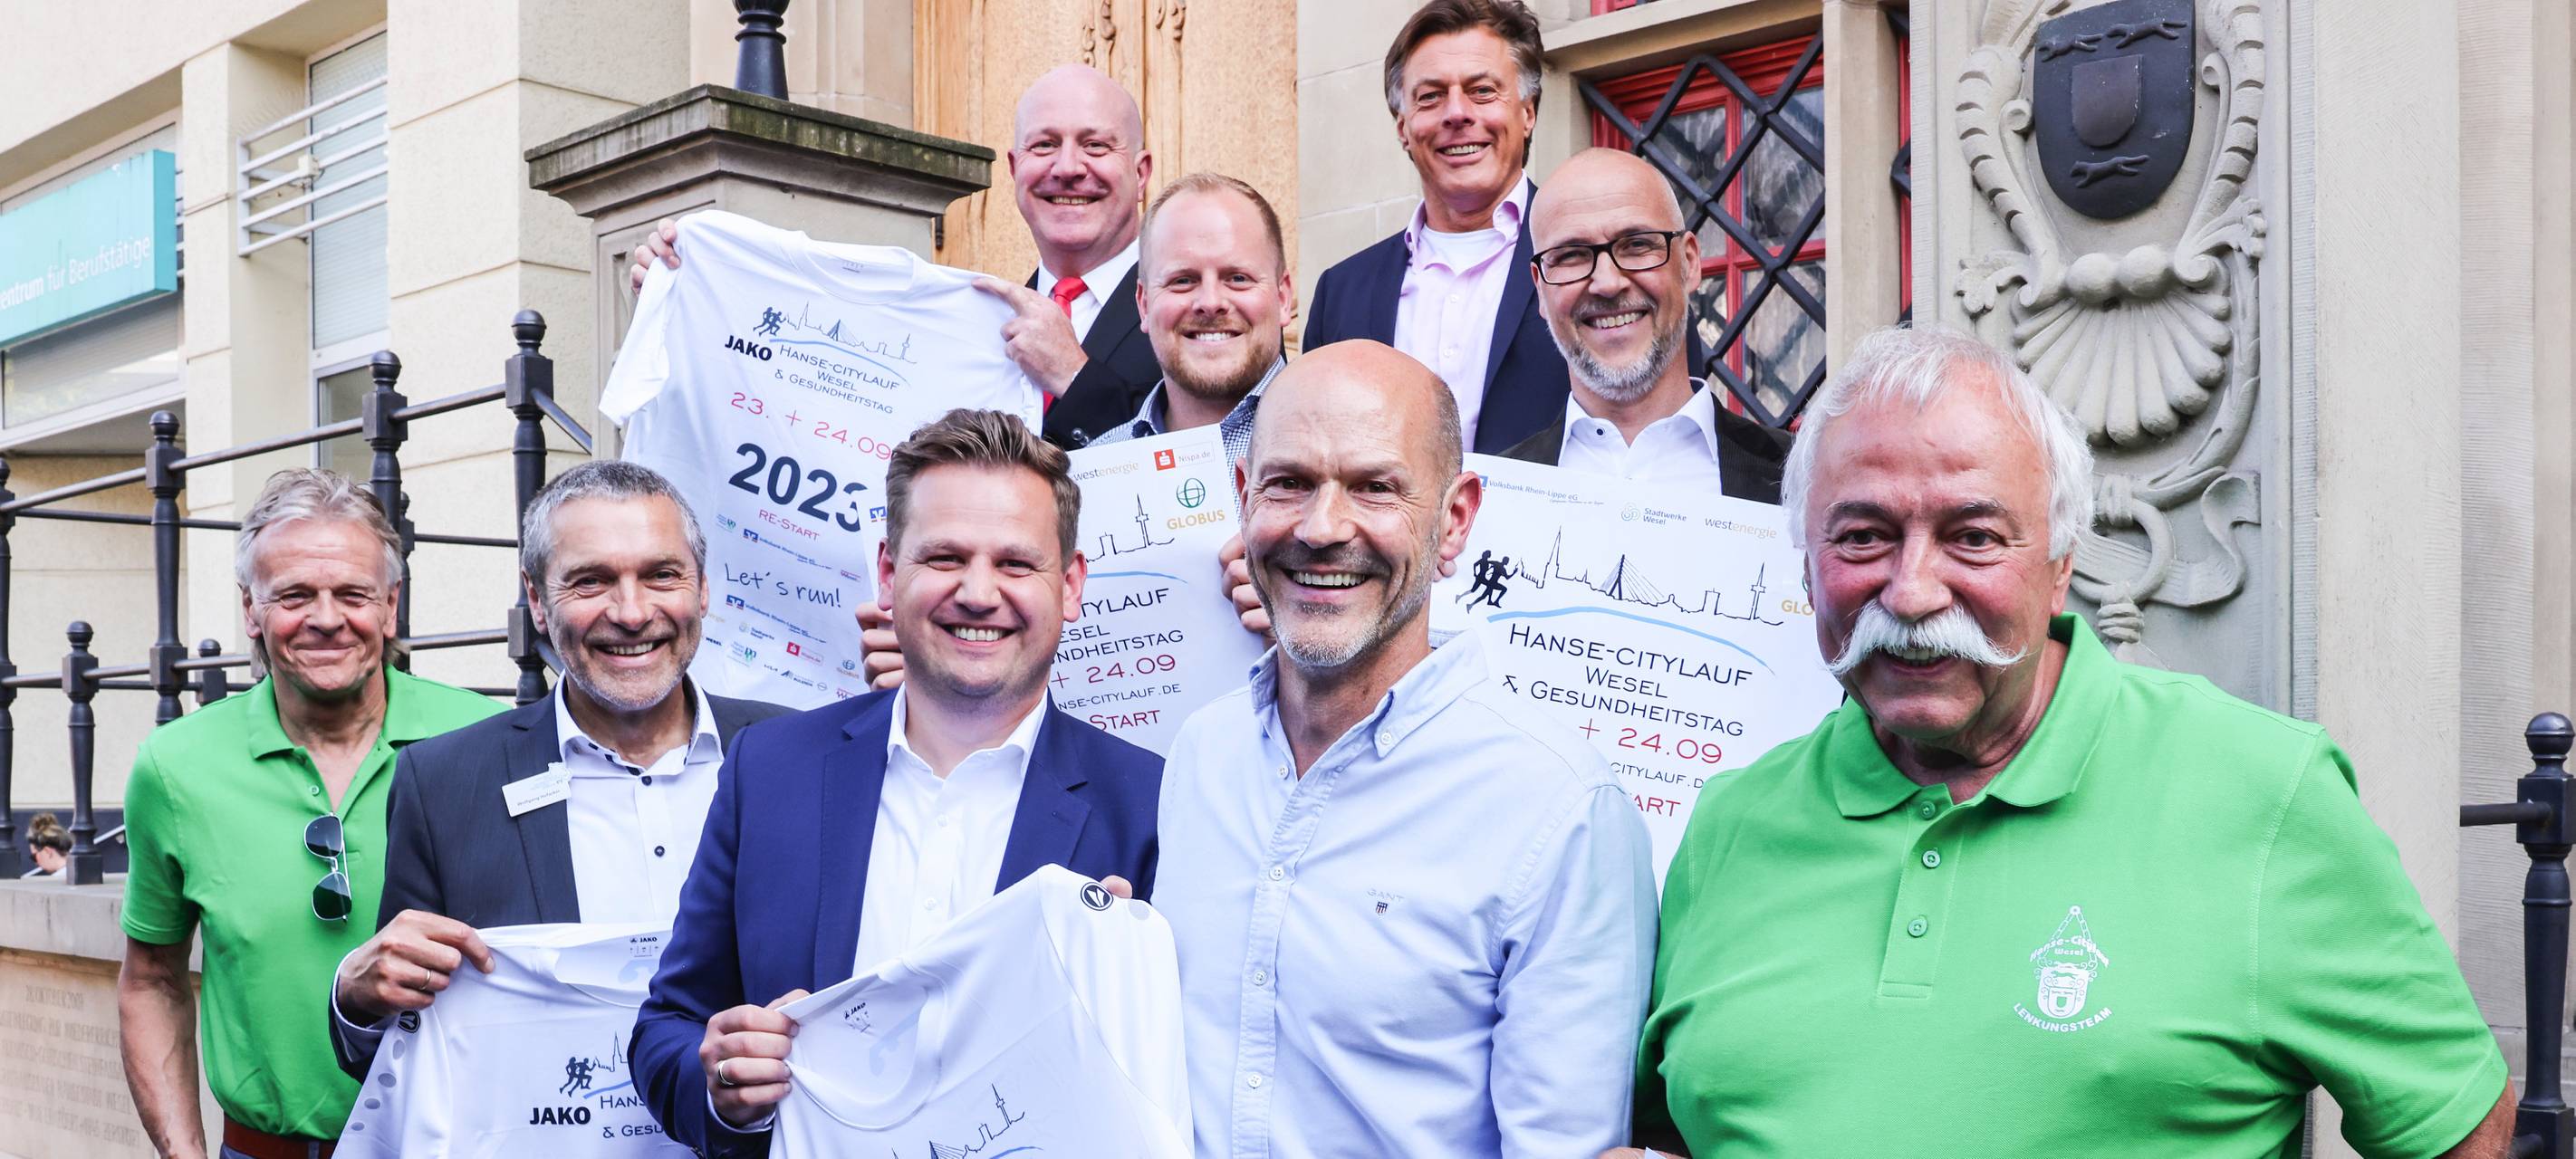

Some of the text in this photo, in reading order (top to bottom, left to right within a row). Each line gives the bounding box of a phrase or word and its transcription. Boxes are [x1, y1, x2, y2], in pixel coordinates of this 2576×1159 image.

[0, 236, 150, 310] entrum für Berufstätige
[725, 335, 773, 361] JAKO
[780, 344, 900, 390] HANSE-CITYLAUF
[774, 369, 894, 414] & GESUNDHEITSTAG
[817, 371, 858, 392] WESEL
[731, 392, 891, 460] 23. + 24.09
[1073, 462, 1139, 482] westenergie
[728, 443, 868, 532] 2023
[1489, 480, 1523, 493] Volksbank
[1525, 486, 1567, 500] Rhein-Lippe
[759, 509, 820, 541] RE-START
[1167, 510, 1226, 530] GLOBUS
[1643, 515, 1666, 525] Wesel
[1644, 507, 1687, 522] Stadtwerke
[1705, 518, 1777, 539] westenergie
[796, 586, 841, 608] run!
[1081, 589, 1168, 618] TYLAUF
[1782, 599, 1813, 616] GLO
[1053, 630, 1184, 664] NDHEITSTAG
[1060, 625, 1110, 644] ESEL
[1509, 623, 1753, 686] HANSE-CITYLAUF
[1051, 655, 1176, 688] + 24.09
[1586, 666, 1668, 698] WESEL
[1058, 684, 1182, 711] NSE-CITYLAUF.DE
[1531, 681, 1744, 737] GESUNDHEITSTAG
[1089, 710, 1160, 731] START
[1579, 718, 1722, 764] + 24.09
[1610, 762, 1704, 789] CITYLAUF.D
[1634, 795, 1681, 817] ART
[2014, 1002, 2112, 1032] LENKUNGSTEAM
[601, 1095, 645, 1109] HAN
[529, 1106, 591, 1125] JAKO
[602, 1125, 664, 1138] & GESU
